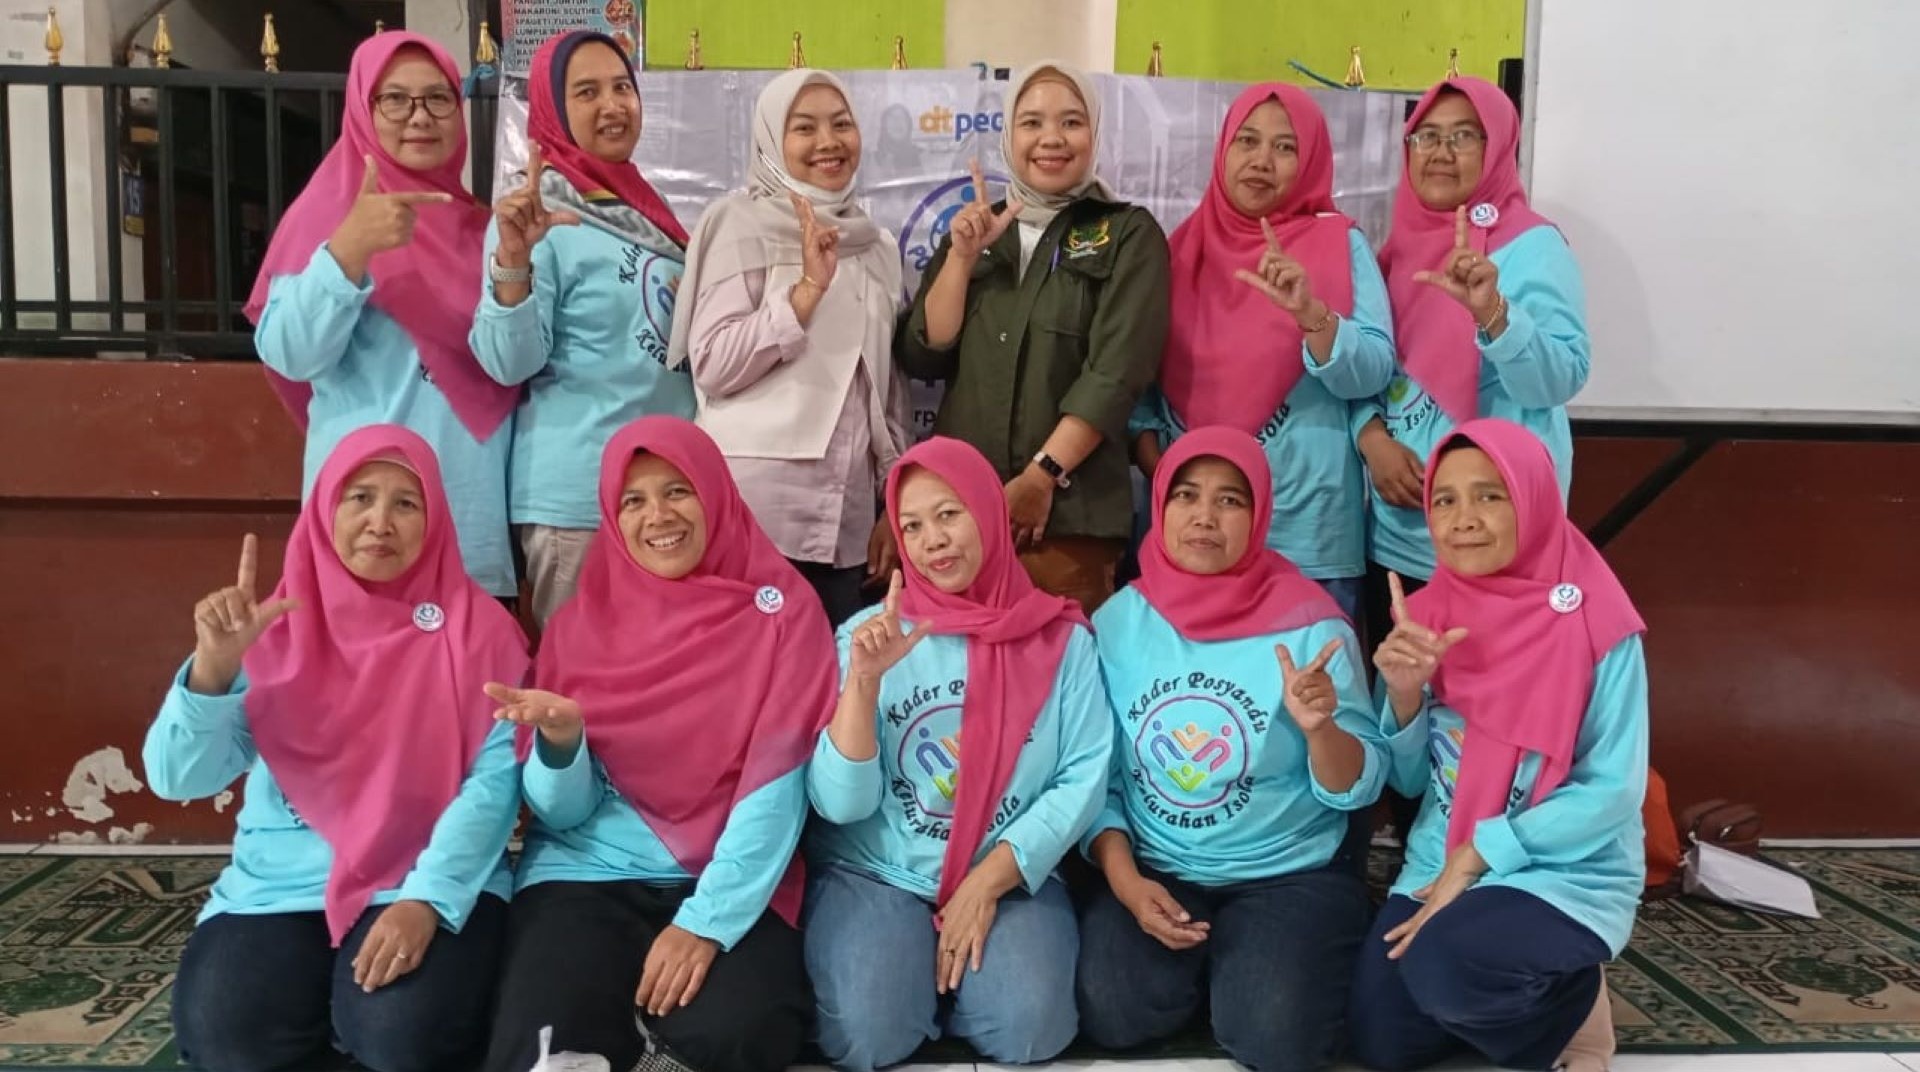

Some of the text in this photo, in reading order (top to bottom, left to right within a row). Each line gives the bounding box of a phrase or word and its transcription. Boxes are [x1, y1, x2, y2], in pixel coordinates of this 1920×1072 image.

[888, 684, 941, 728] Kader
[1128, 671, 1269, 734] Kader Posyandu
[891, 776, 951, 841] Keluraha
[1222, 776, 1254, 819] Isola
